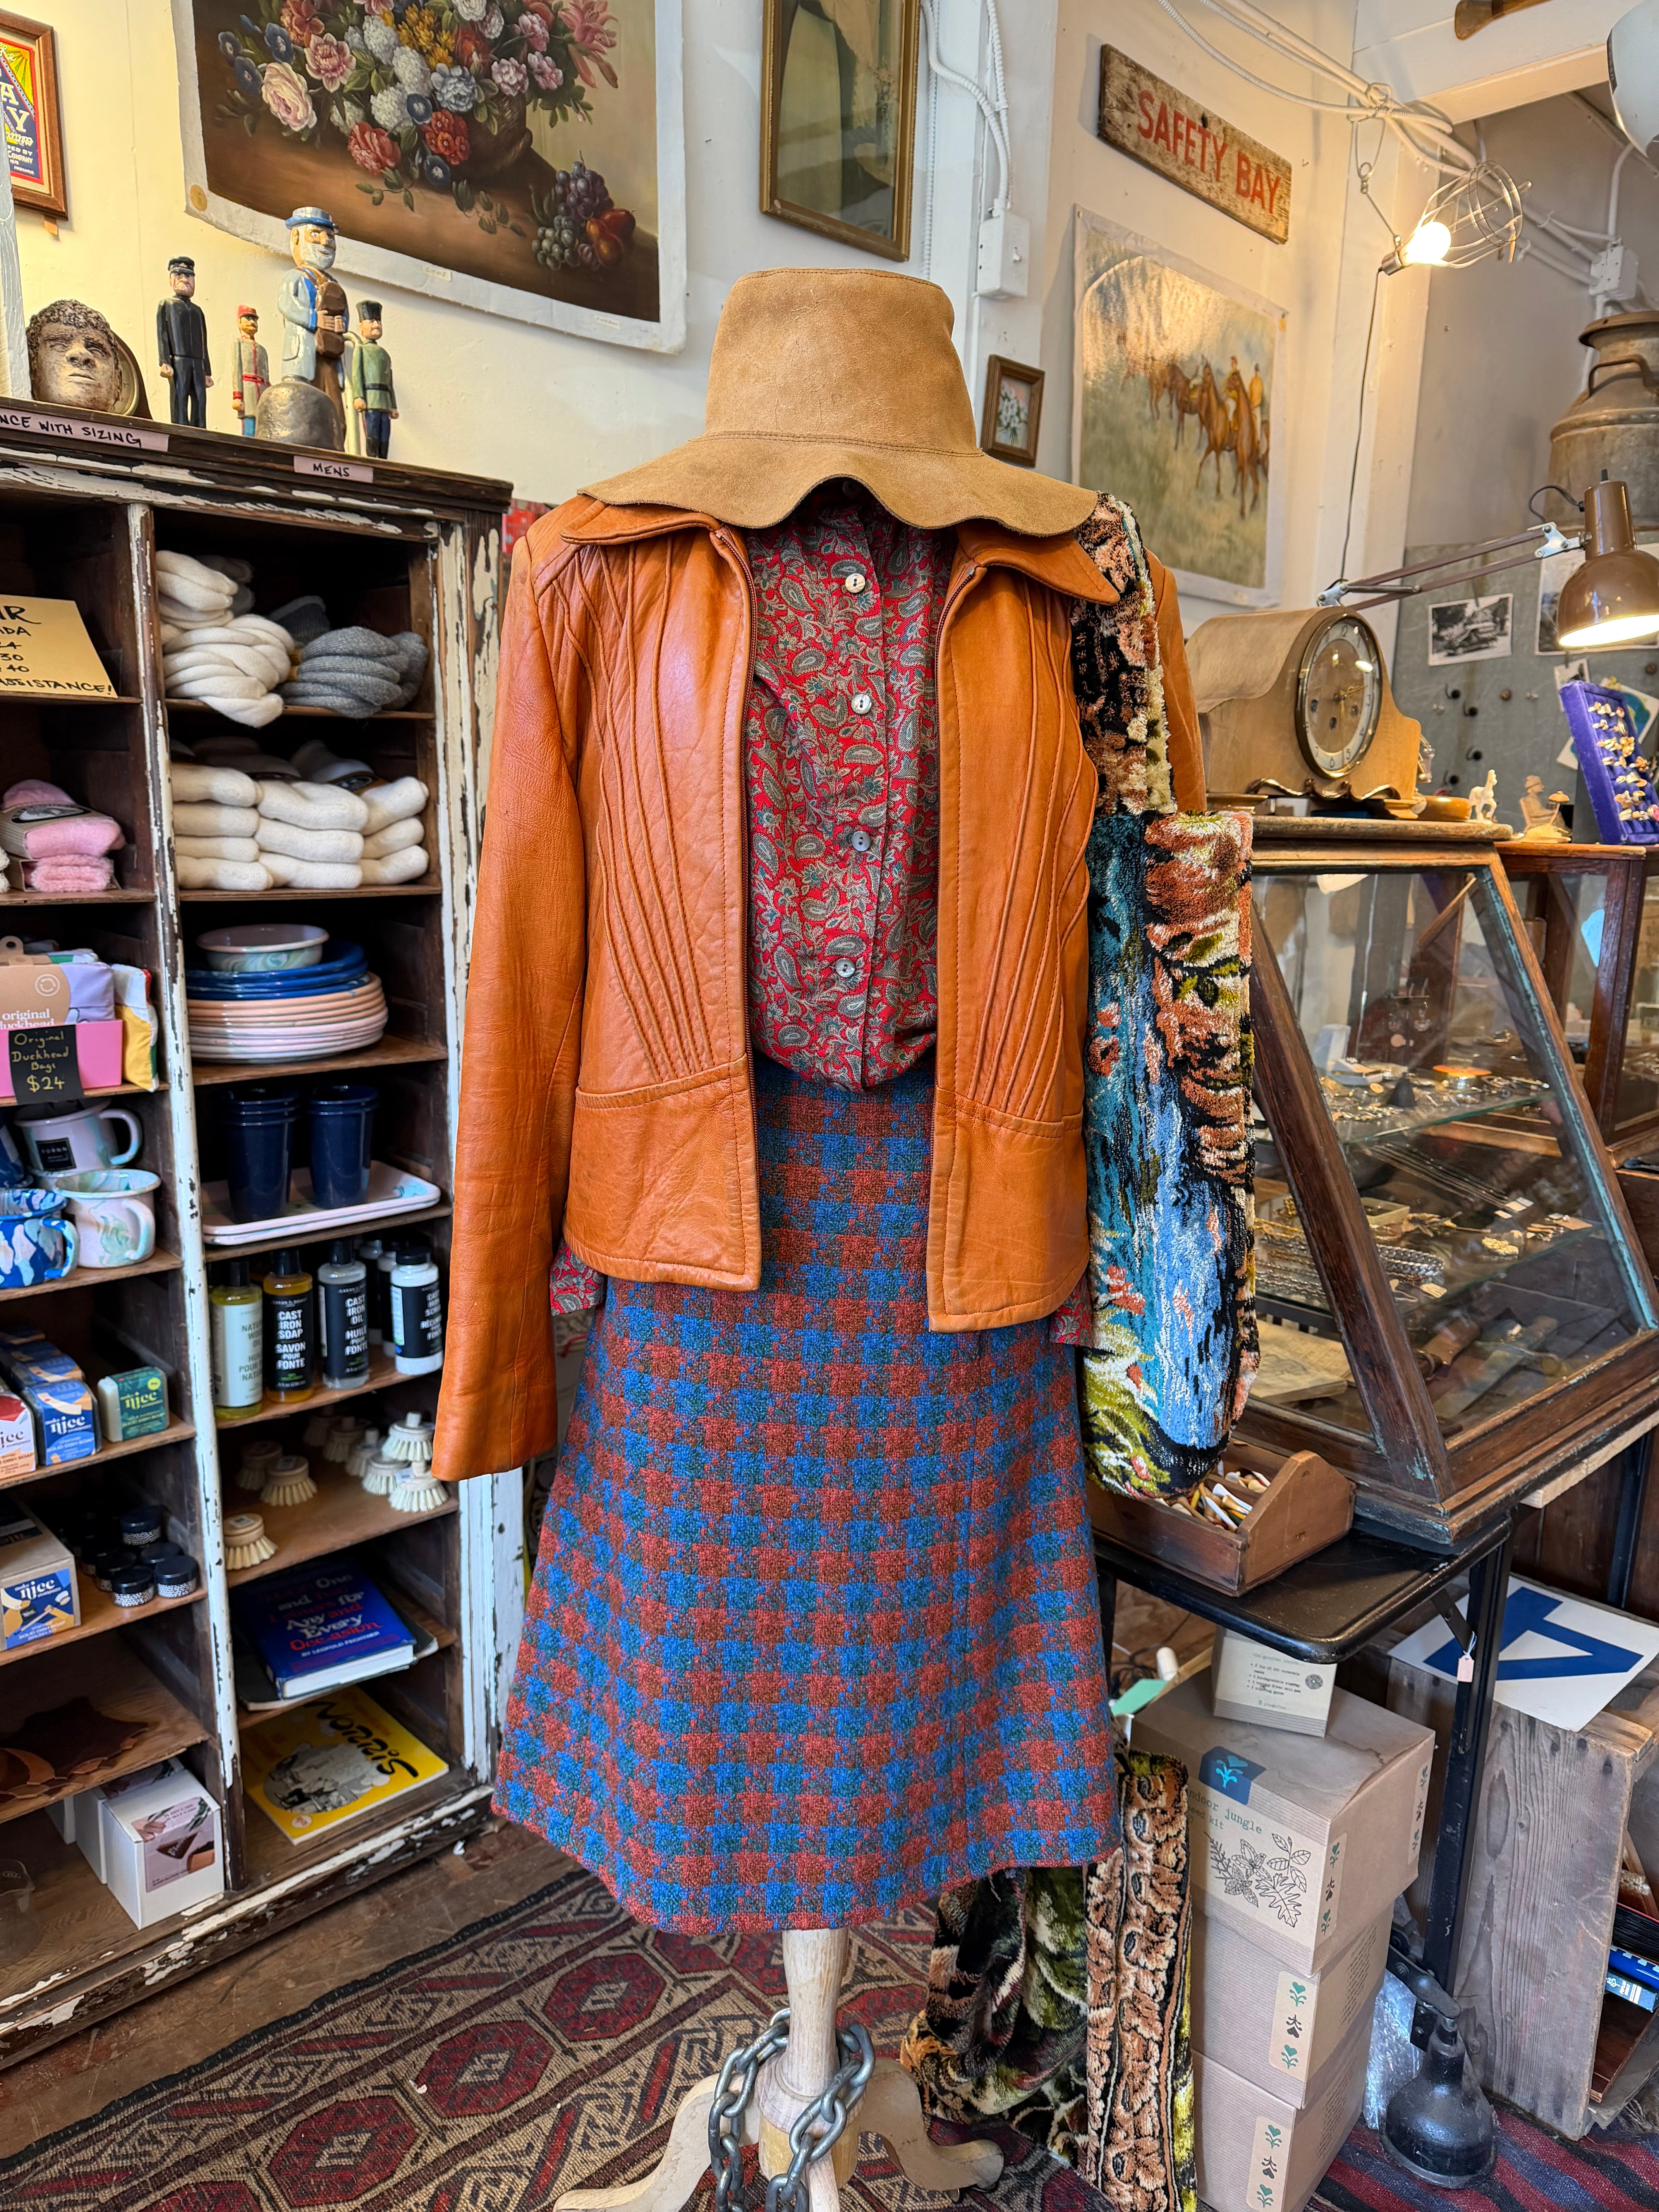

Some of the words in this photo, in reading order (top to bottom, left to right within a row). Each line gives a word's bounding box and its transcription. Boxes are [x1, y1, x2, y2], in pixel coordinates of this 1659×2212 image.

[8, 150, 33, 164] COMPANY
[1138, 90, 1228, 182] SAFETY
[1236, 151, 1281, 214] BAY
[39, 421, 73, 434] WITH
[82, 427, 142, 447] SIZING
[313, 463, 349, 477] MENS
[1341, 625, 1348, 637] 12
[2, 1008, 50, 1022] original
[14, 1030, 64, 1049] Original
[11, 1046, 69, 1062] Duckhead
[31, 1061, 56, 1073] Bags
[27, 1074, 65, 1093] $24
[345, 1294, 365, 1308] CAST
[277, 1309, 302, 1321] CAST
[347, 1304, 365, 1317] IRON
[278, 1319, 302, 1330] IRON
[350, 1314, 364, 1325] OIL
[277, 1328, 303, 1340] SOAP
[345, 1325, 367, 1340] HUILE
[275, 1341, 306, 1354] SAVON
[345, 1340, 368, 1356] FONTE
[276, 1358, 305, 1370] FONTE
[338, 1591, 365, 1606] for
[286, 1613, 325, 1631] Any
[328, 1601, 363, 1619] and
[299, 1614, 363, 1640] Every
[290, 1622, 384, 1651] Occasion
[1188, 1806, 1205, 1819] eed
[1209, 1815, 1224, 1830] kit
[1224, 1808, 1262, 1834] jungle
